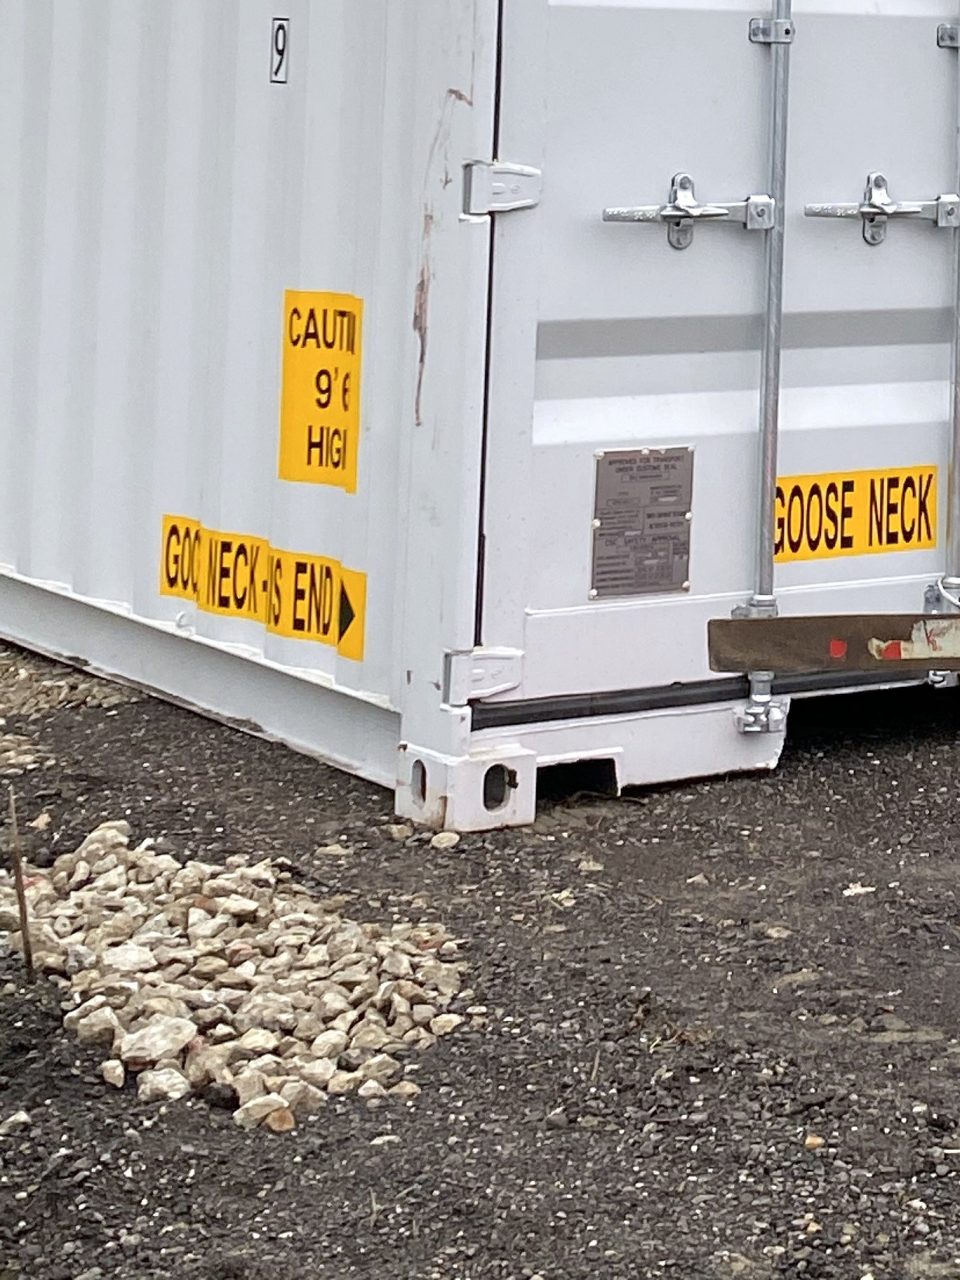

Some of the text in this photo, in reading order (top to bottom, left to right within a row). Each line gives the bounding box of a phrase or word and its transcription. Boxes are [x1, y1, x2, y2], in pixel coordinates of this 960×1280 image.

[273, 23, 286, 77] 9
[774, 473, 934, 555] GOOSE NECK
[206, 537, 260, 614] NECK
[293, 561, 333, 636] END
